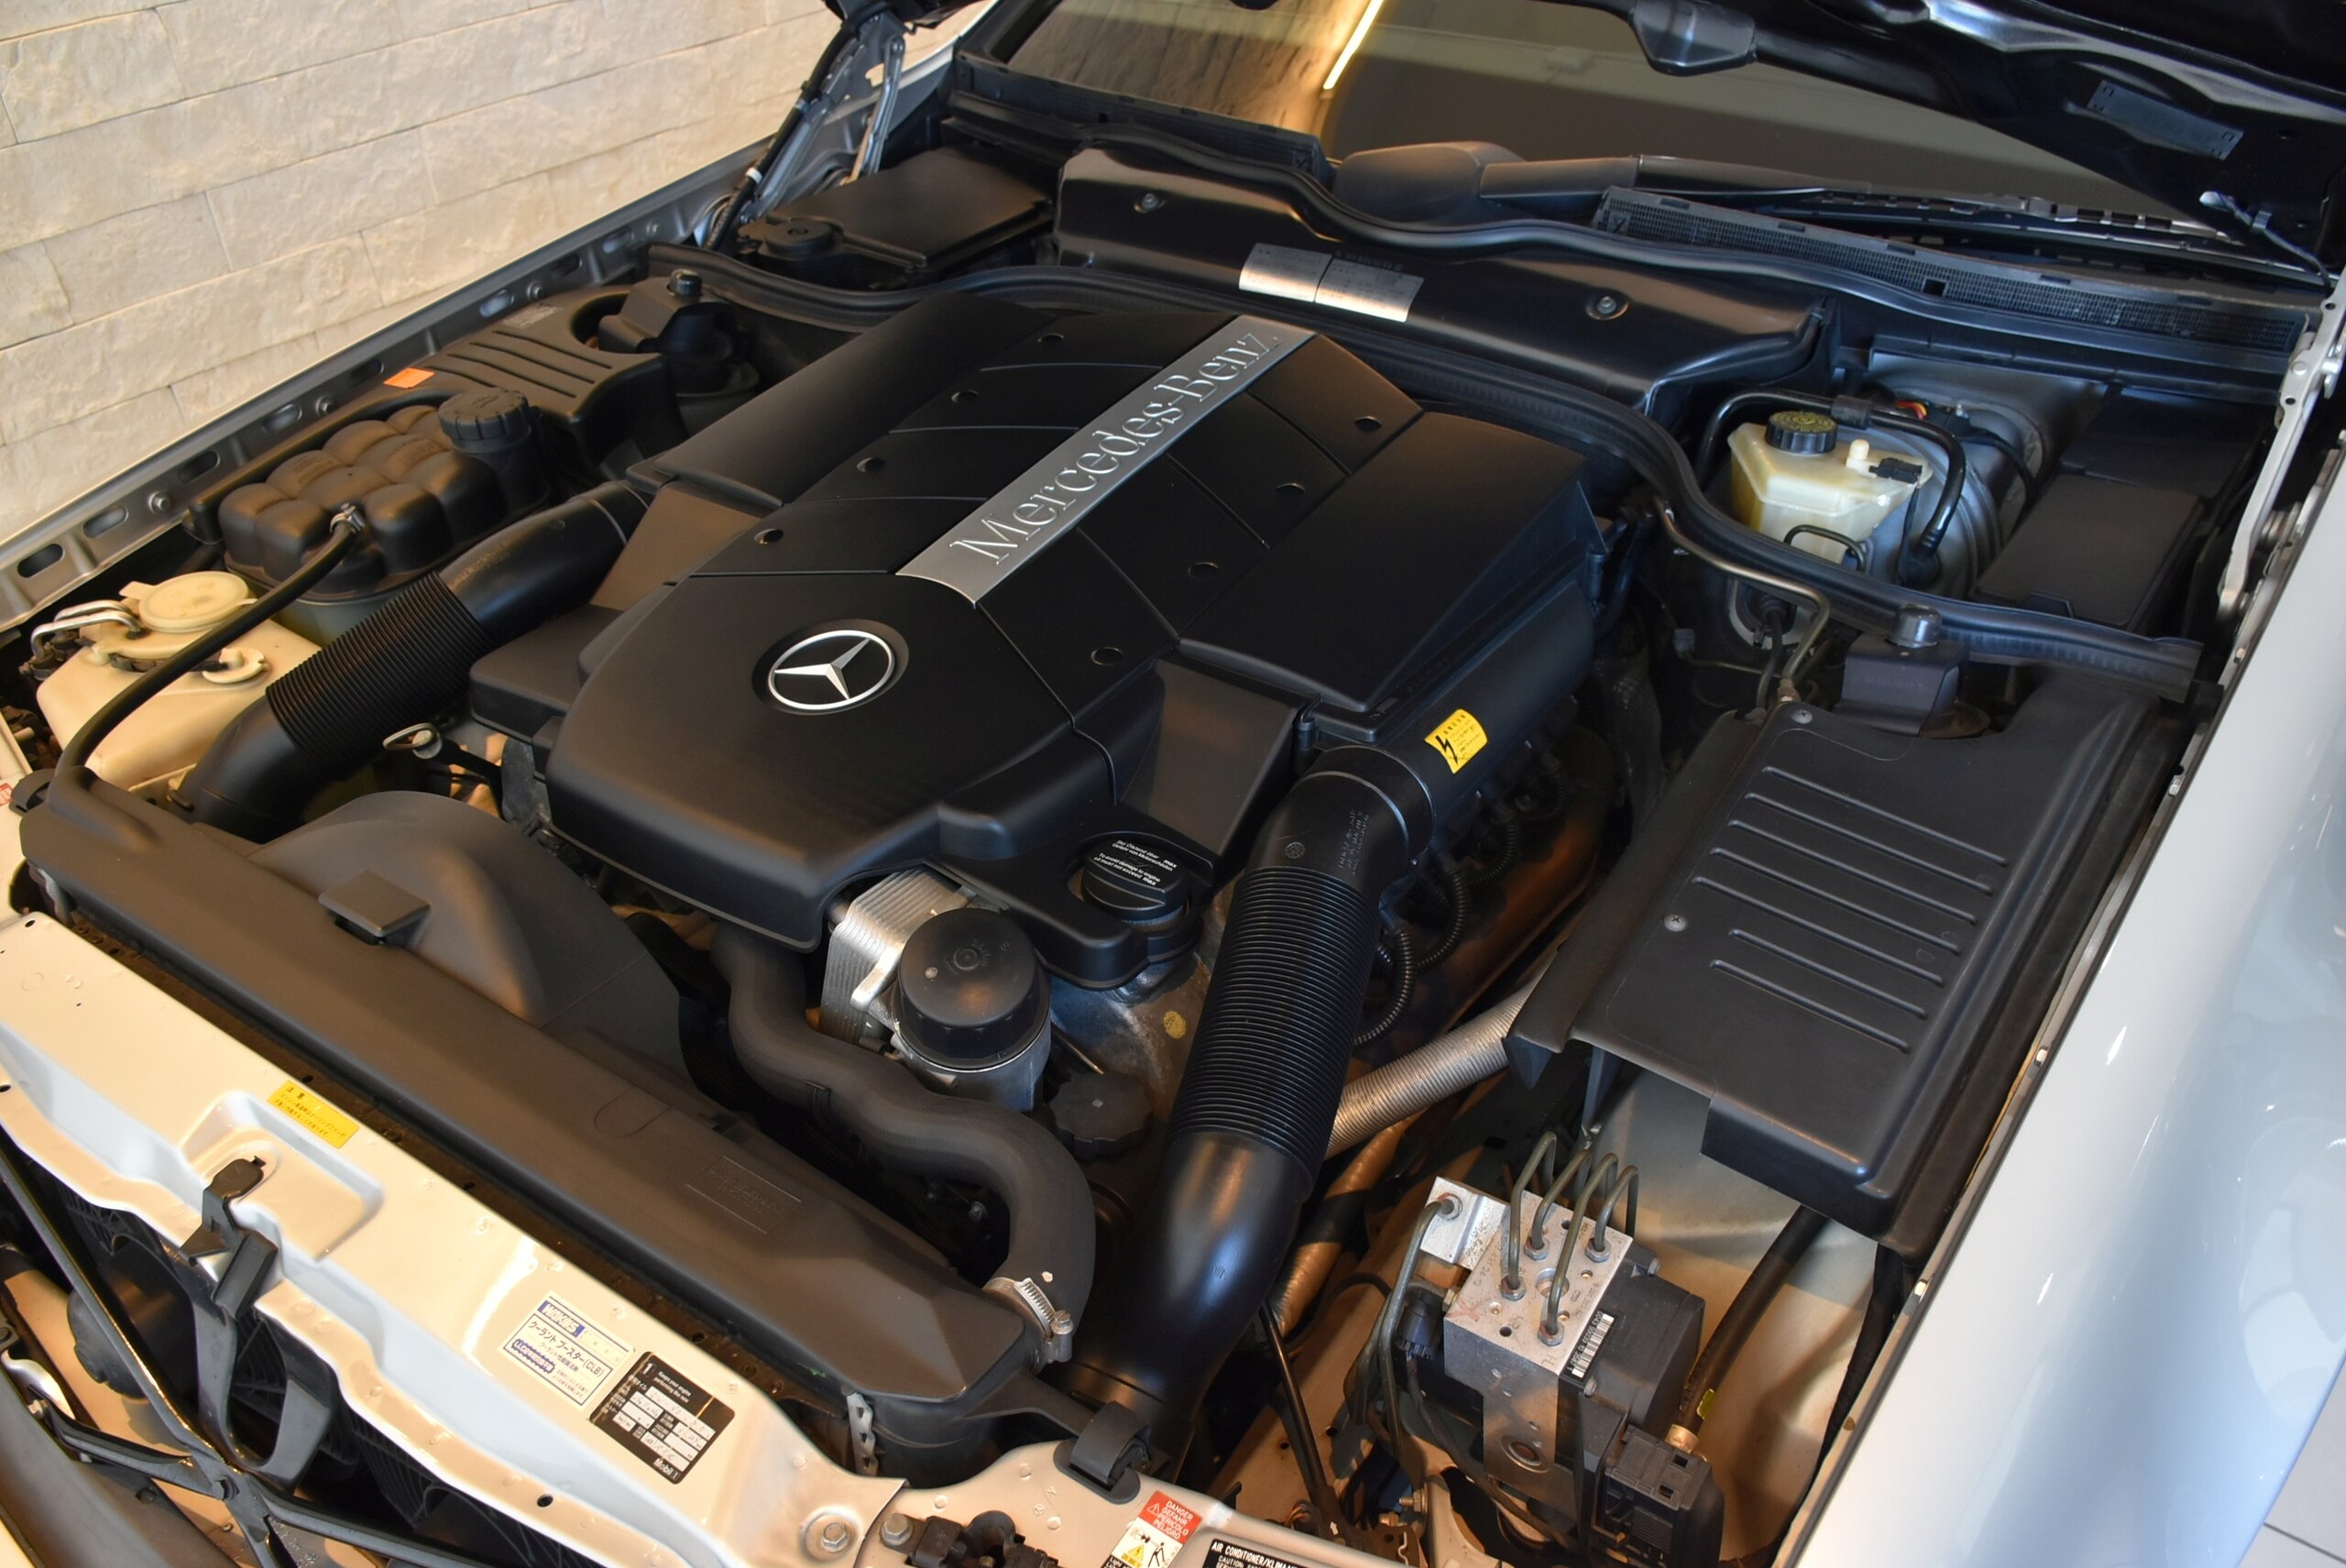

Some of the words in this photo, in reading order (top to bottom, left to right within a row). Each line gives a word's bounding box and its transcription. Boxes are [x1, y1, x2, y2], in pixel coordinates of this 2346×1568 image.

[949, 333, 1278, 565] Mercedes-Benz
[1118, 861, 1138, 872] damage
[1143, 872, 1161, 883] engine
[1163, 860, 1178, 869] max
[1122, 868, 1143, 879] exceed
[1142, 876, 1157, 886] max
[528, 1321, 556, 1343] クーラント
[653, 1458, 674, 1475] Mobil
[1161, 1507, 1188, 1527] GEFAHR
[1166, 1500, 1193, 1521] DANGER
[1153, 1519, 1181, 1540] PELIGRO
[1157, 1513, 1189, 1536] PERICOLO
[1211, 1541, 1223, 1552] AIR
